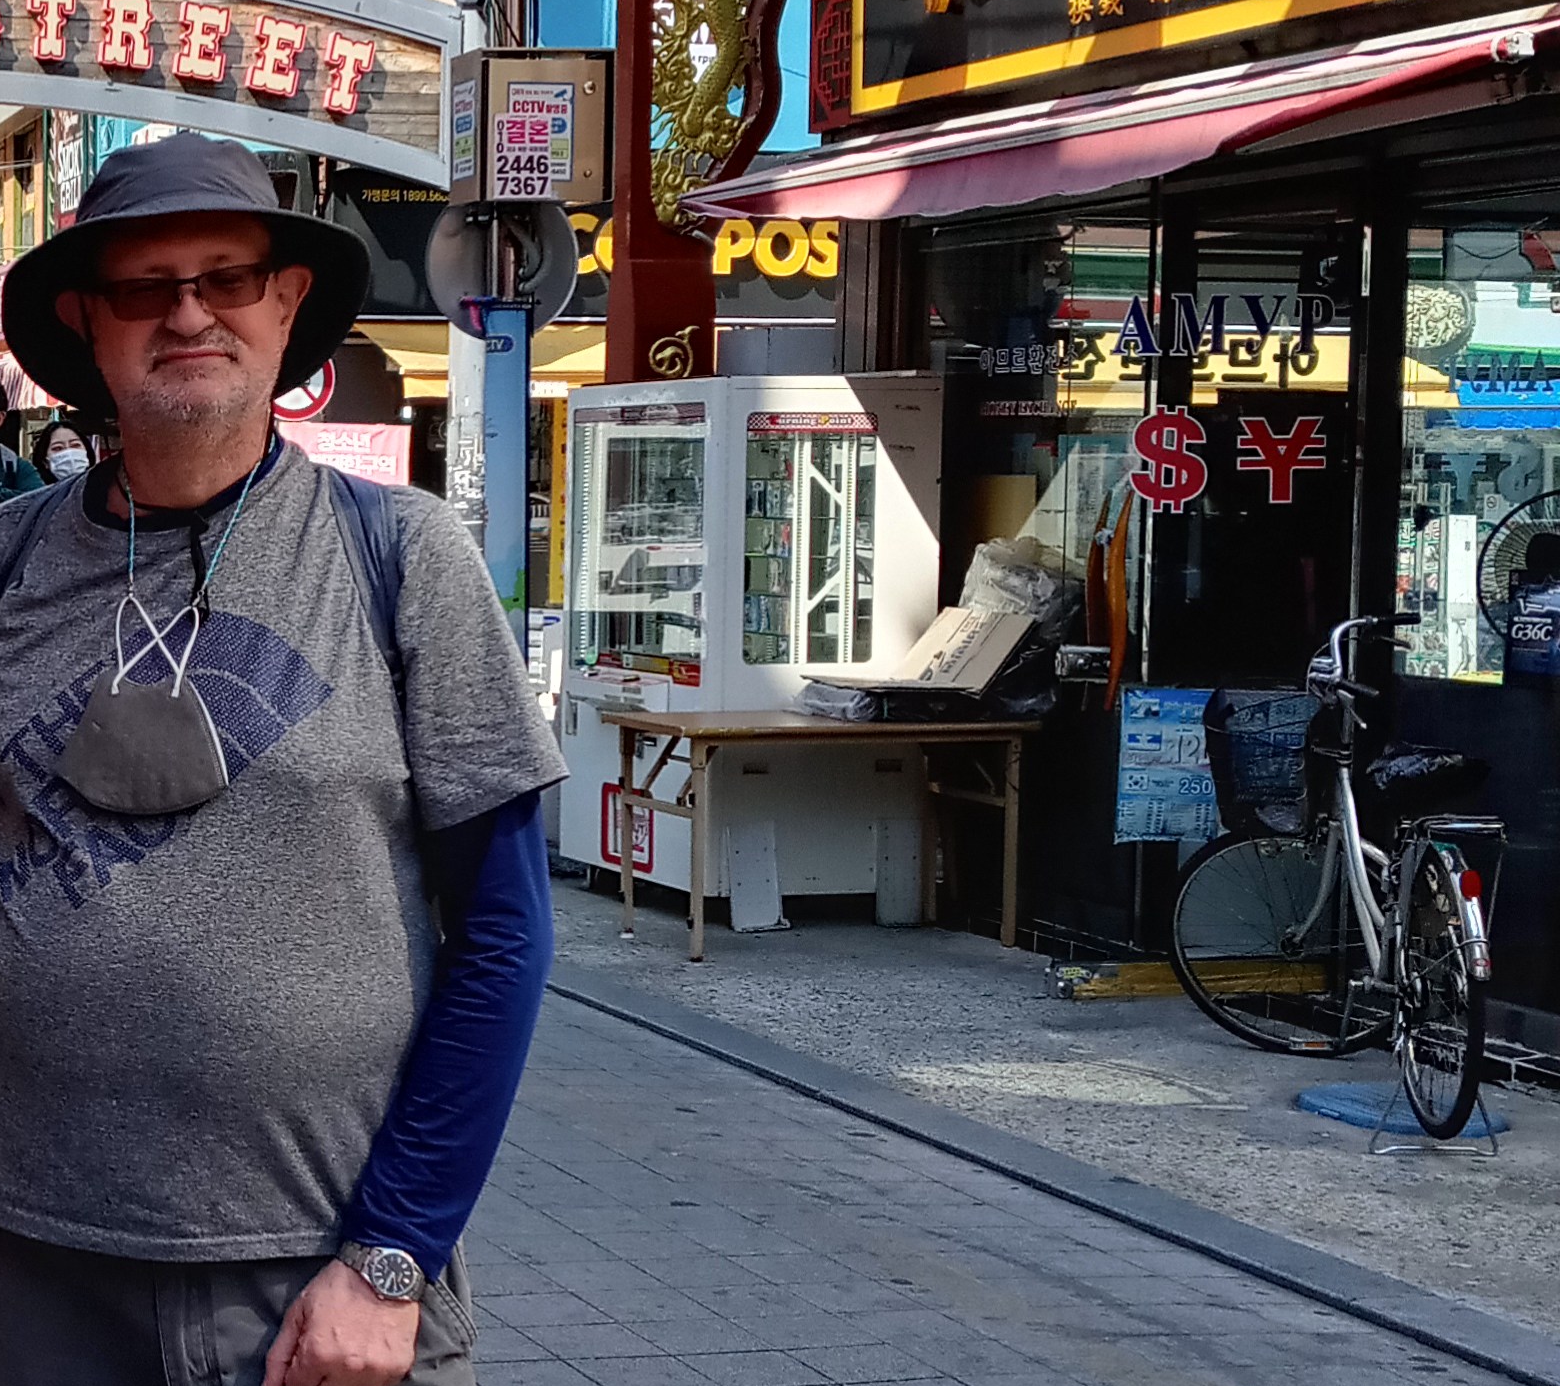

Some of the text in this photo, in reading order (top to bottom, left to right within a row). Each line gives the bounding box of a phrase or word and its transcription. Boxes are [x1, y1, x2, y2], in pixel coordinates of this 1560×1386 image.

[512, 100, 546, 114] CCTV
[496, 119, 505, 154] 010
[506, 119, 549, 145] 결혼
[496, 154, 549, 174] 2446
[361, 188, 400, 203] 가맹문의
[496, 176, 549, 196] 7367
[317, 429, 372, 453] 청소년
[1129, 404, 1208, 514] $
[1178, 778, 1213, 795] 250
